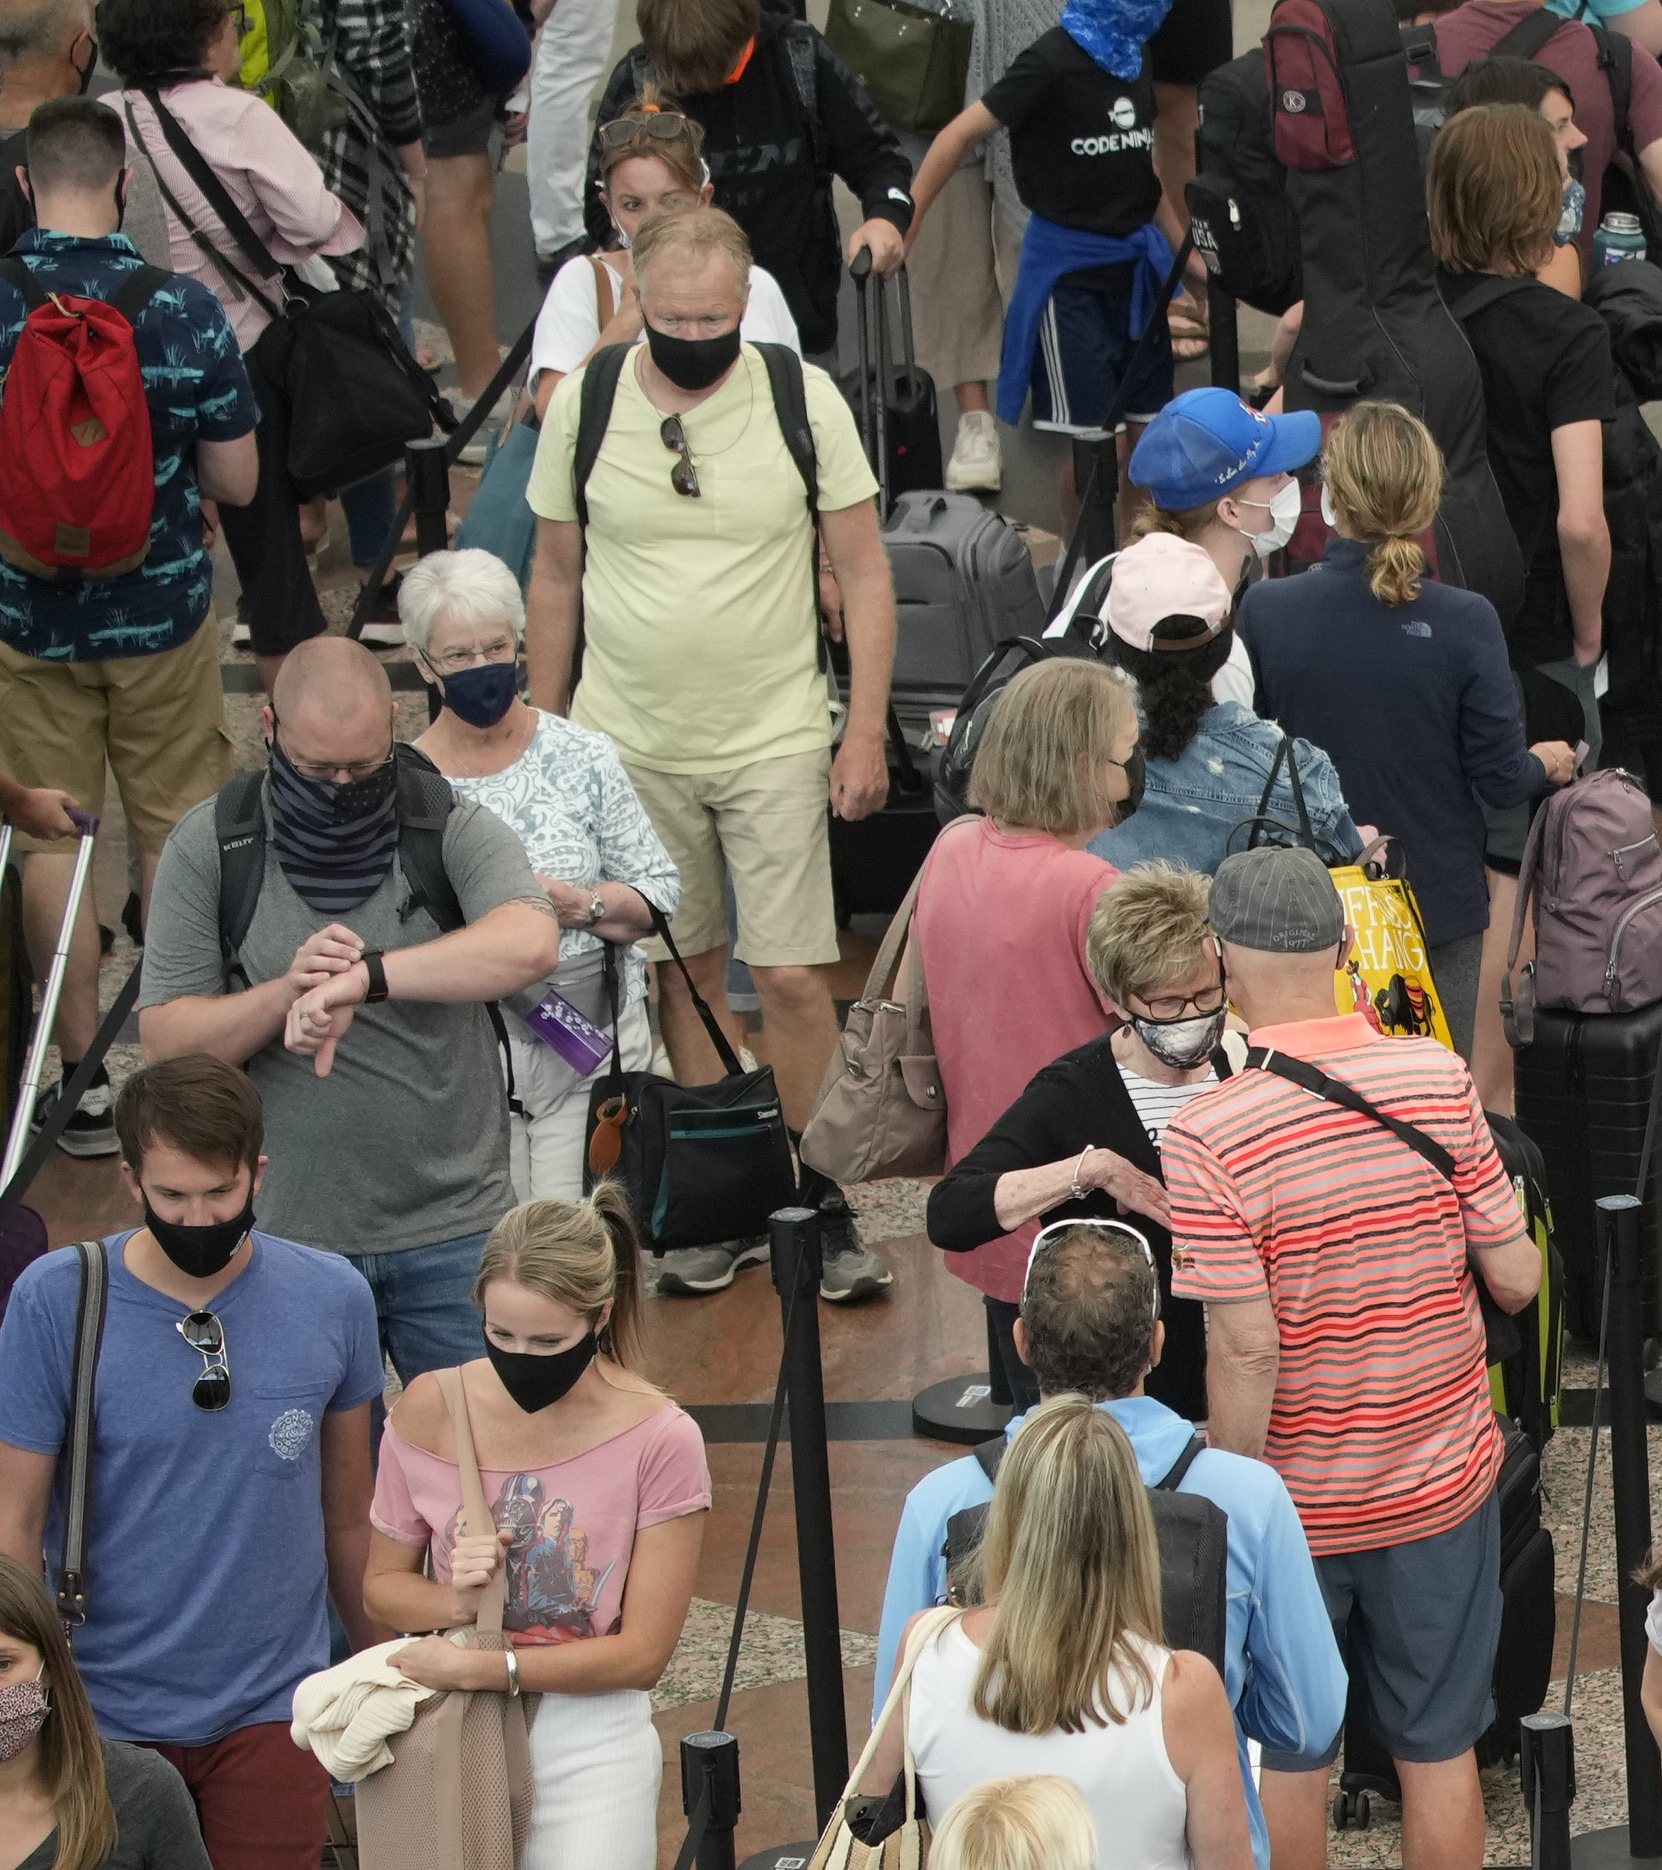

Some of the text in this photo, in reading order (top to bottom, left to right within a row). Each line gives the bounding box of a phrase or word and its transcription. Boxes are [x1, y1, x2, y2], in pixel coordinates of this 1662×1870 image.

[1071, 128, 1154, 155] CODE NINJ
[1192, 227, 1219, 250] USA
